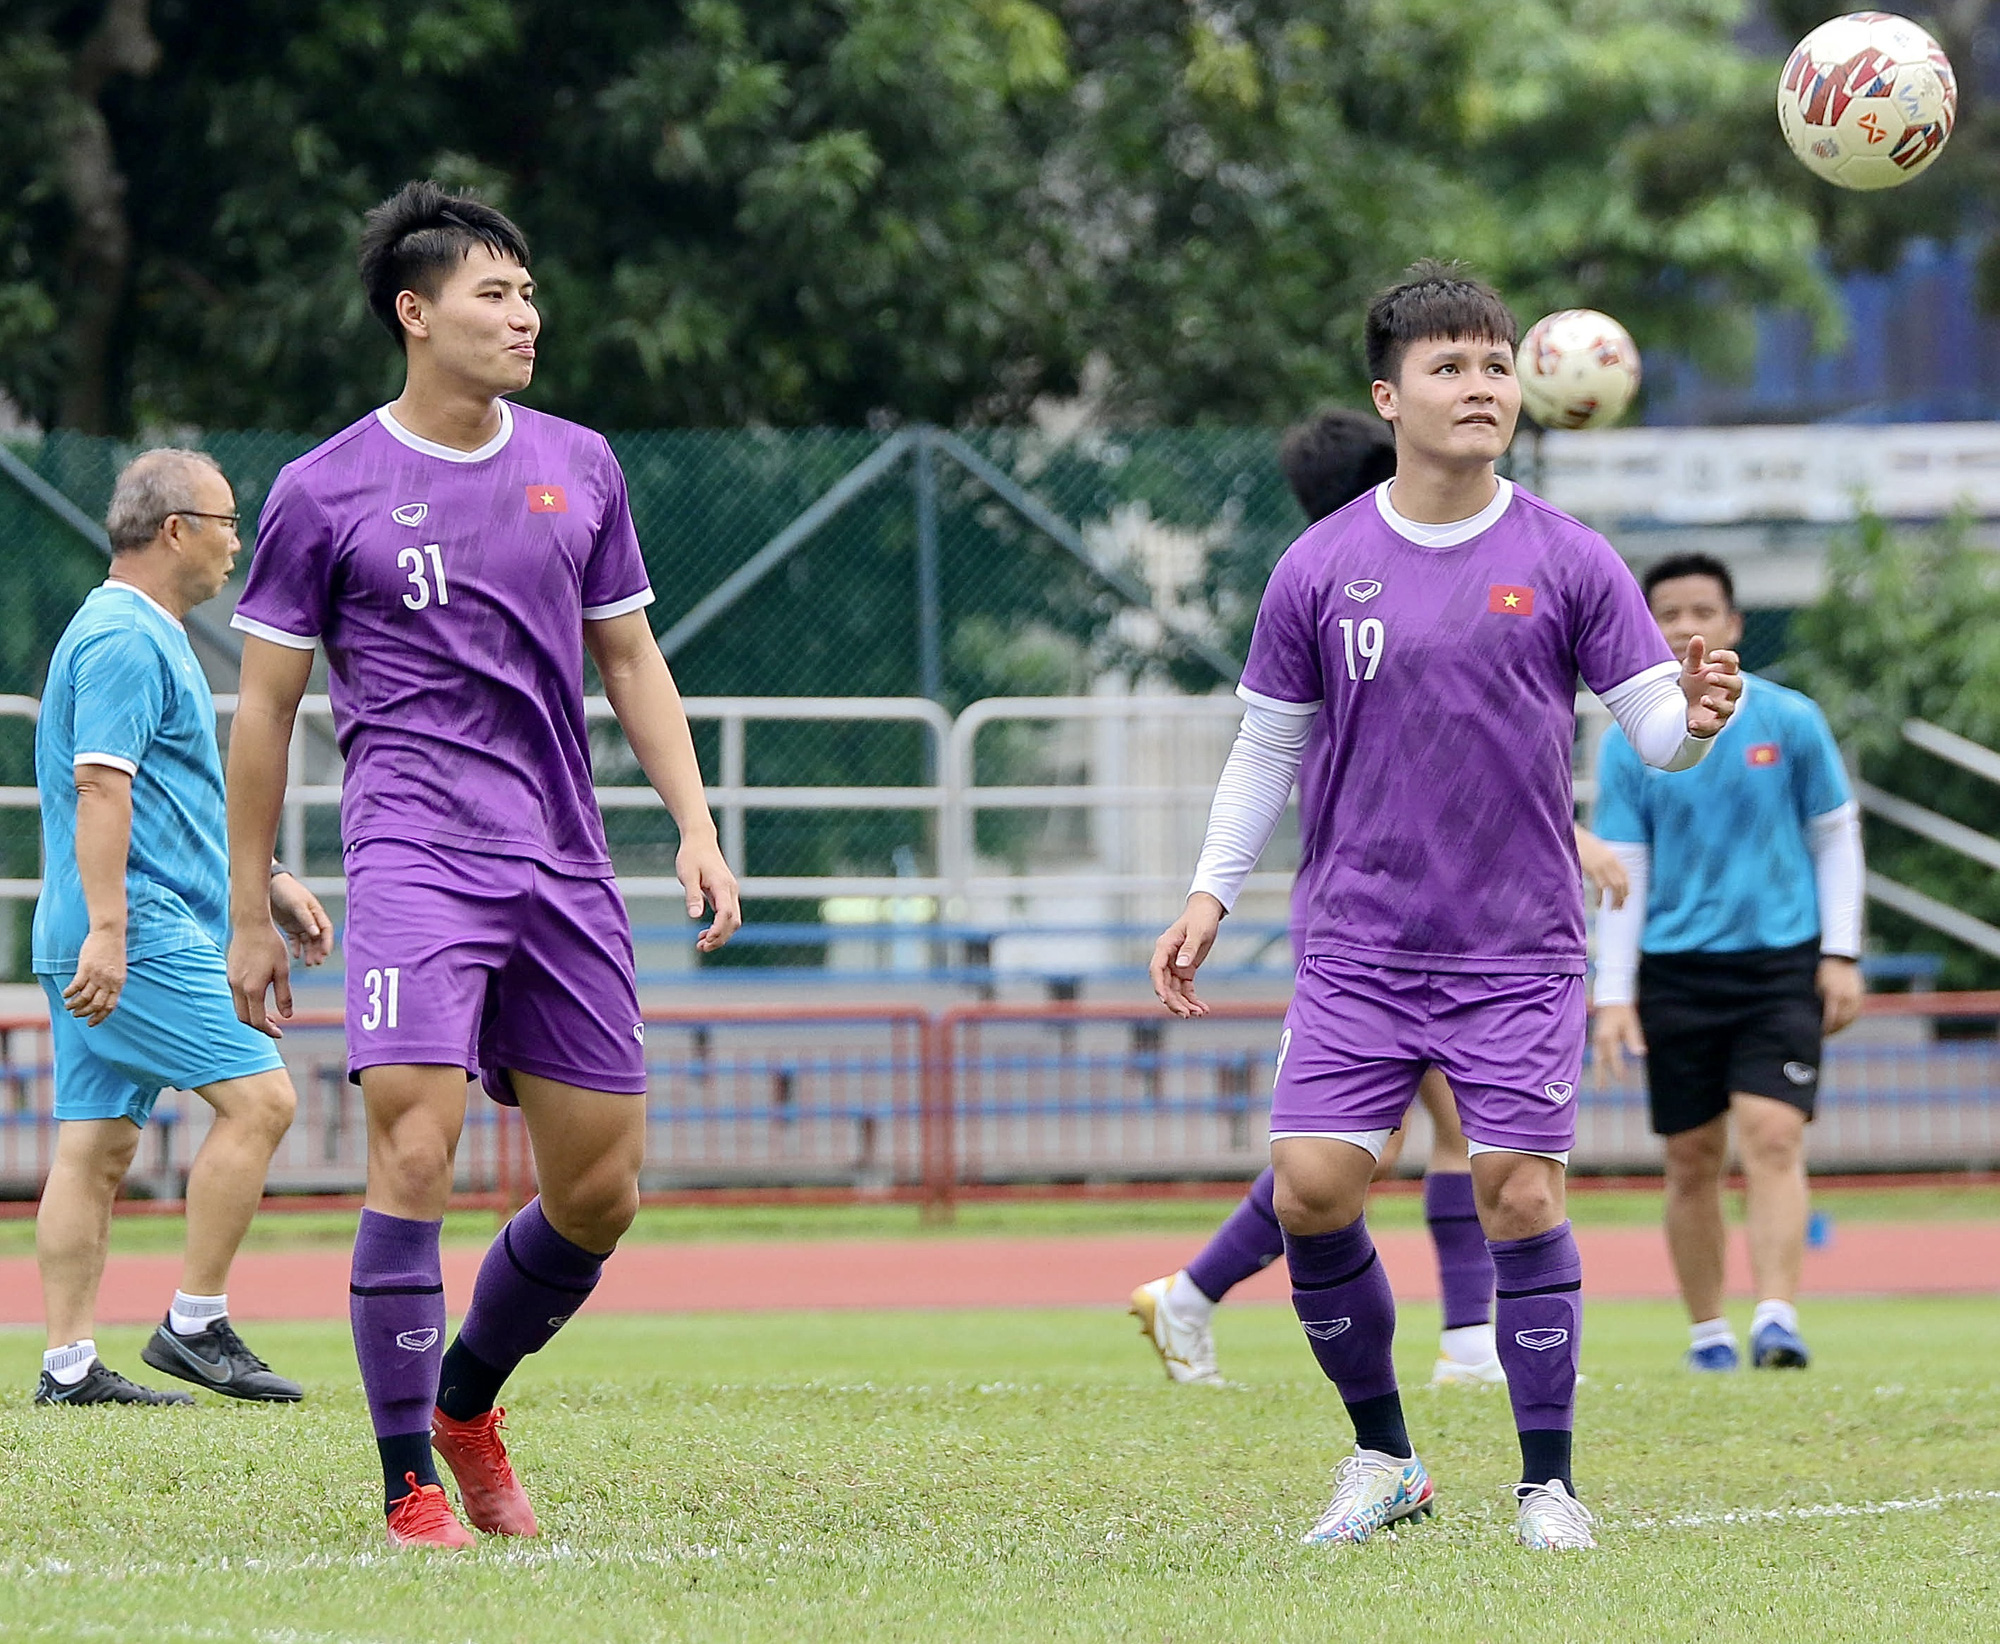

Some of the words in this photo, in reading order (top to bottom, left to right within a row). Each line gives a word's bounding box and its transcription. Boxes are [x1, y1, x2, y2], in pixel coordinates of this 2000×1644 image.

[396, 543, 449, 611] 31
[1338, 617, 1385, 681] 19
[361, 967, 400, 1031] 31
